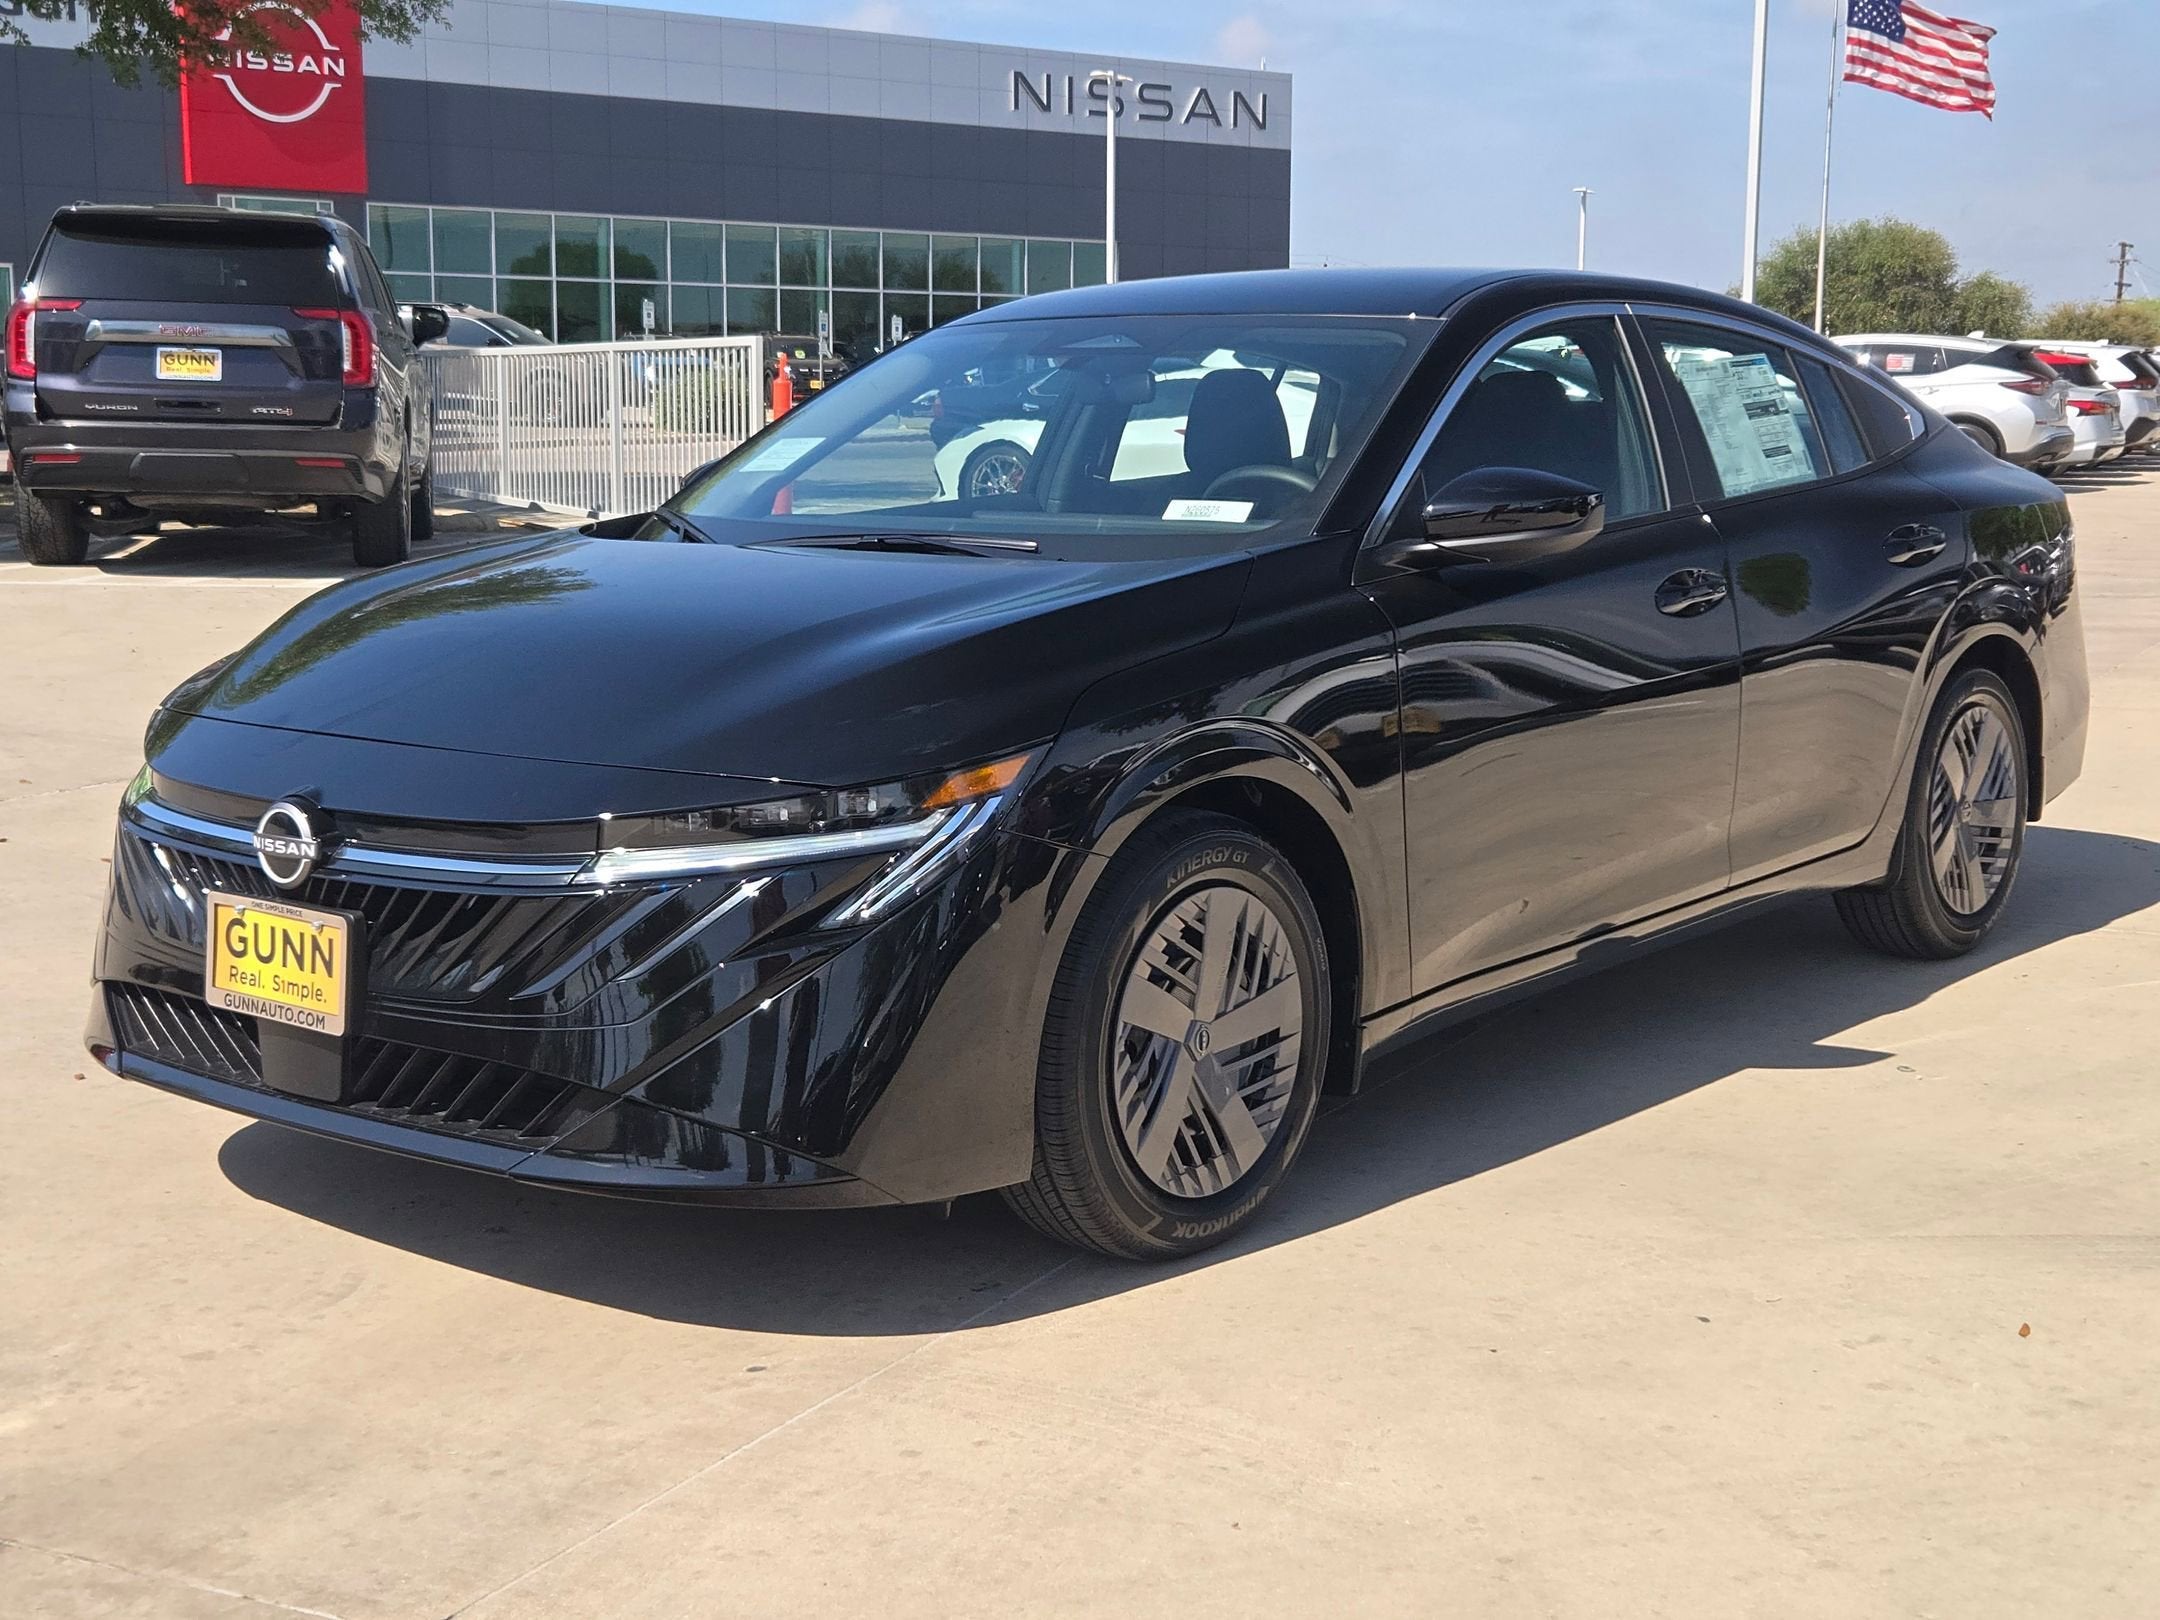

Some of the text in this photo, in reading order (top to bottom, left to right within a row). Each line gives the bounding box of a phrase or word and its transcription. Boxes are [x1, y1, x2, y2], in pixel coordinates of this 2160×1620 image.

[1011, 70, 1267, 130] NISSAN
[164, 353, 216, 366] GUNN
[253, 834, 316, 857] NISSAN
[265, 904, 285, 913] SIMPLE
[286, 908, 303, 918] PRICE
[225, 917, 334, 978] GUNN
[229, 965, 265, 989] Real.
[224, 993, 325, 1030] GUNNAUTO.COM
